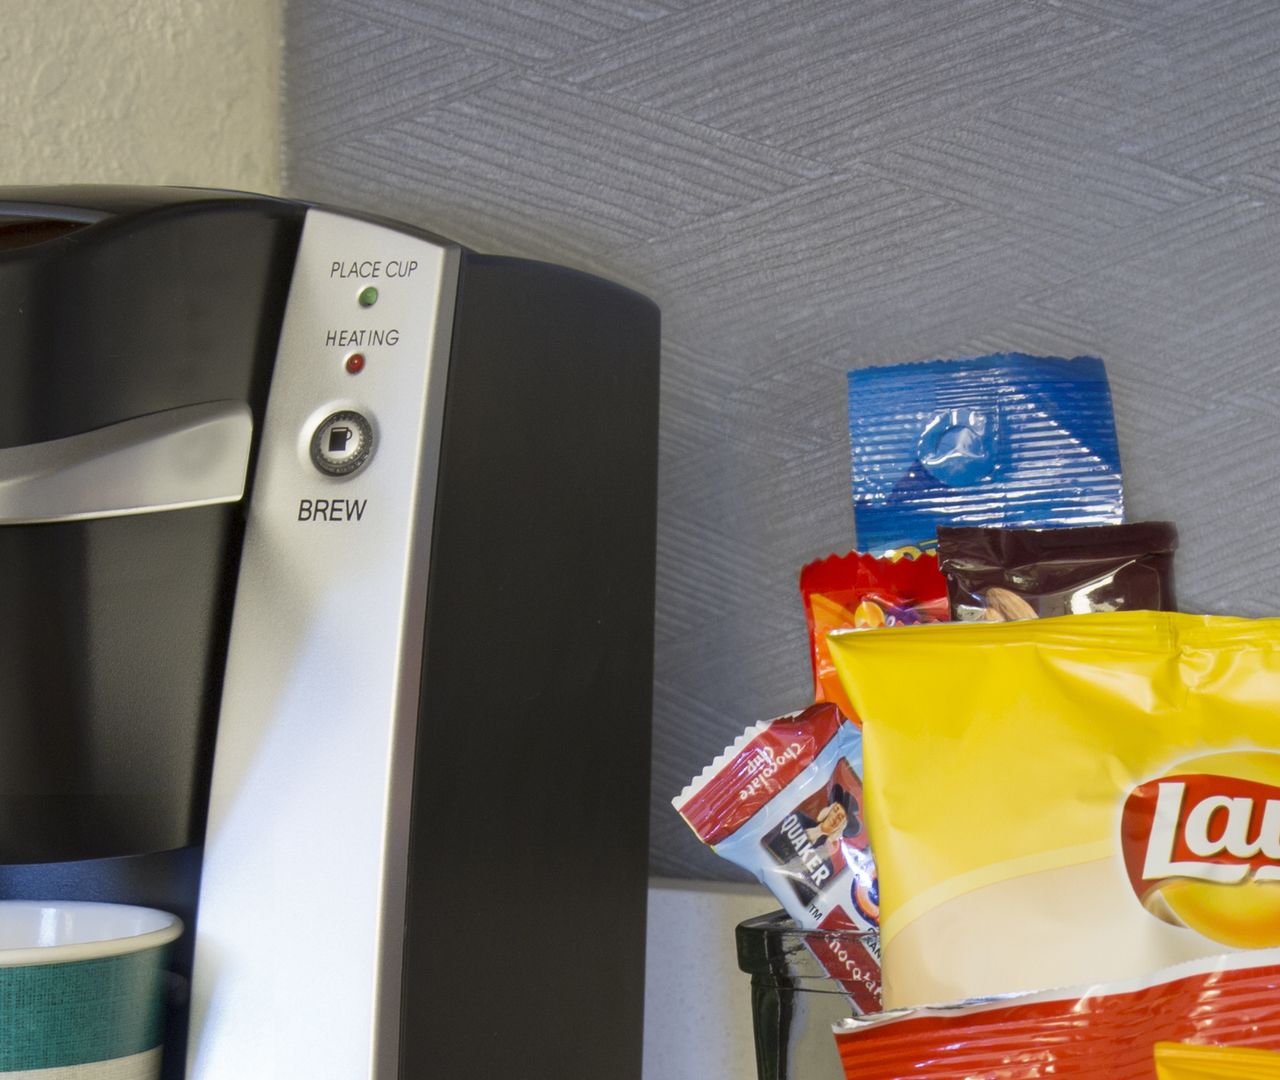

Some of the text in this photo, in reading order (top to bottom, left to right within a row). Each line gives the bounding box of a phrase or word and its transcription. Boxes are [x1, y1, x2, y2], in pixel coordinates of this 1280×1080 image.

[330, 260, 418, 279] PLACE CUP
[325, 329, 400, 347] HEATING
[297, 499, 368, 522] BREW
[780, 814, 832, 887] QUAKER
